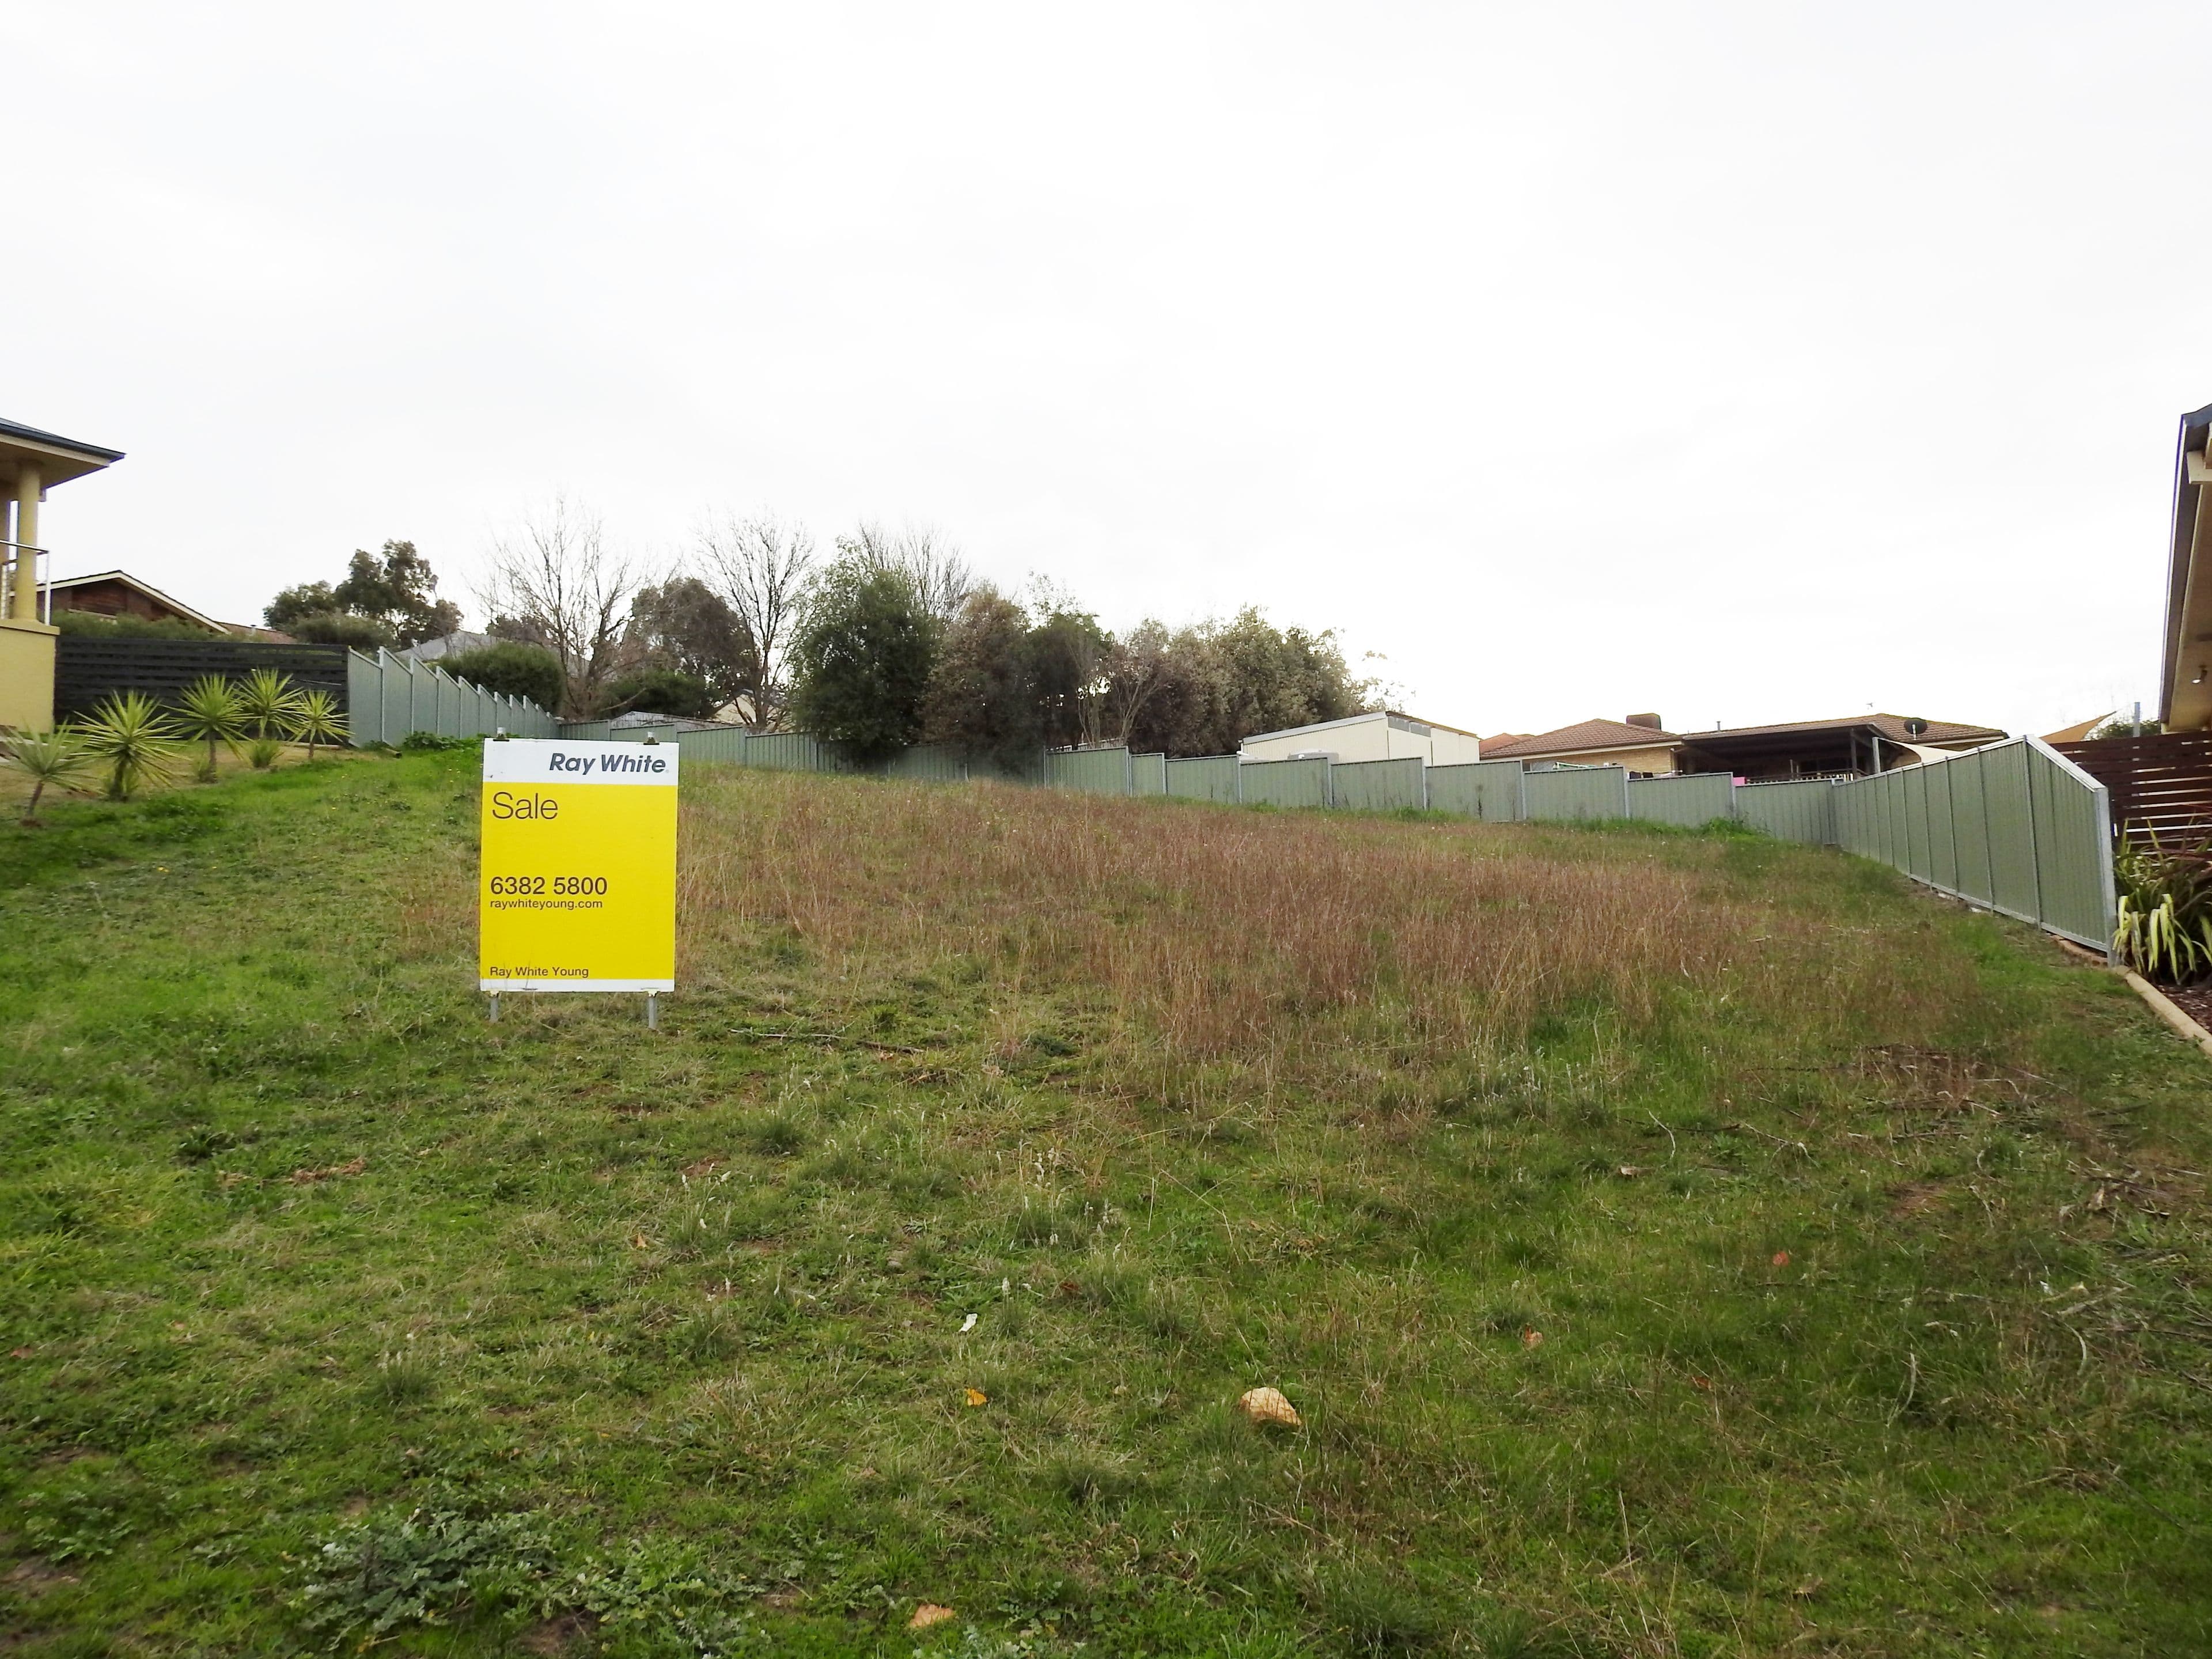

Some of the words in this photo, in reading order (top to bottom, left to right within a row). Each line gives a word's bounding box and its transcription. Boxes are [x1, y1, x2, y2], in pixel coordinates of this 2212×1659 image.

[549, 752, 596, 775] Ray
[601, 754, 666, 774] White
[492, 791, 559, 820] Sale
[490, 876, 546, 896] 6382
[553, 877, 608, 896] 5800
[490, 899, 603, 910] raywhiteyoung.com
[490, 967, 512, 977] Ray
[515, 967, 548, 976] White
[552, 967, 589, 978] Young
